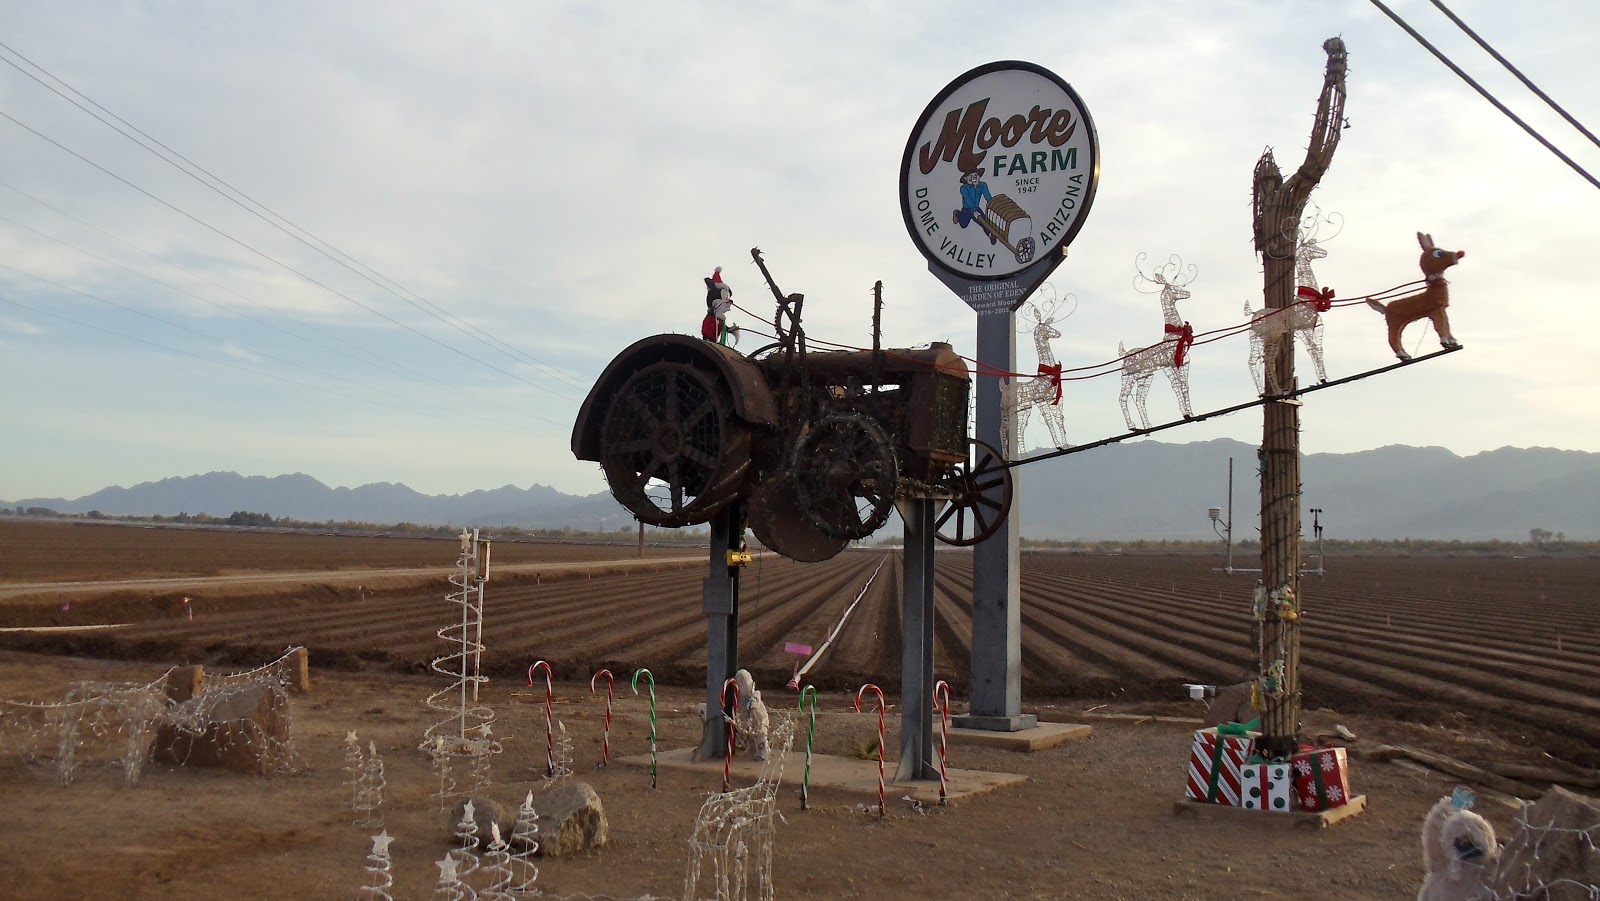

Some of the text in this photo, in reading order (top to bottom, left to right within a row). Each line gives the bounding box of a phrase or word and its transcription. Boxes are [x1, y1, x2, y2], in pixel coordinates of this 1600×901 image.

[919, 97, 1077, 175] Moore
[993, 147, 1078, 177] FARM
[1015, 177, 1040, 187] SINCE
[1017, 185, 1037, 194] 1947
[915, 173, 1083, 269] DOME VALLEY ARIZONA
[968, 281, 1019, 294] THE ORIGINAL
[993, 291, 1004, 299] OF
